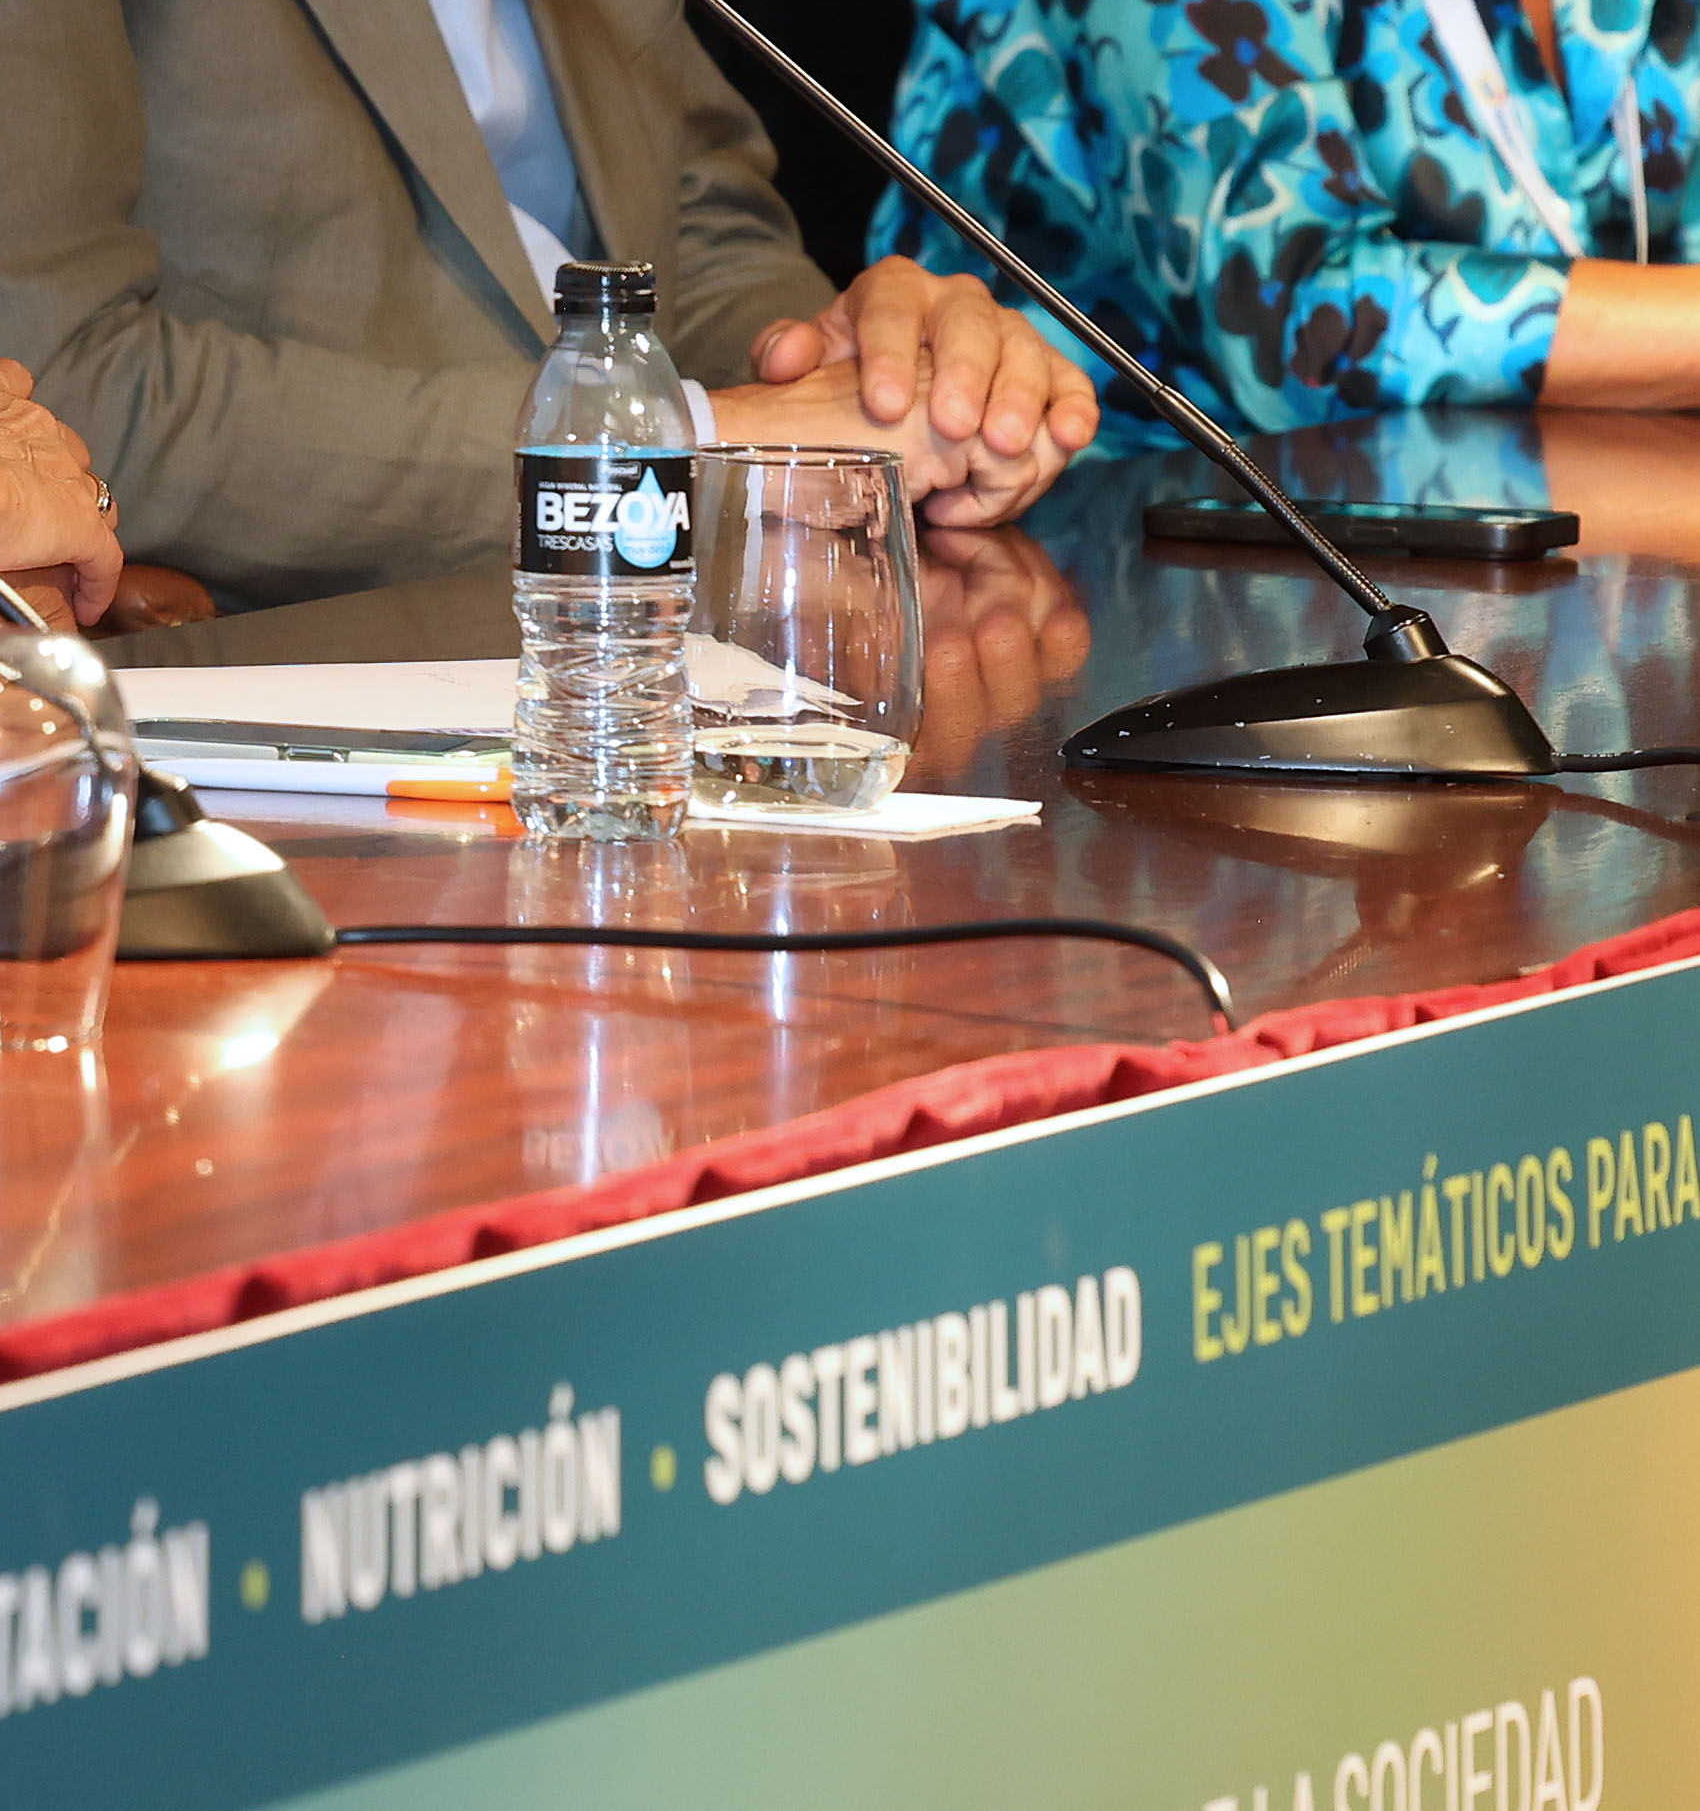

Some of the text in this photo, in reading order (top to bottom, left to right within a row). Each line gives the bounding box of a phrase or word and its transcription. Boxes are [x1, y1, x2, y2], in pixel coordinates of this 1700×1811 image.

[536, 491, 690, 532] BEZOYA
[537, 534, 614, 552] TRESCASAS
[300, 1380, 621, 1624] NUTRICIÓN
[704, 1265, 1142, 1505] SOSTENIBILIDAD
[1192, 1218, 1312, 1363] EJES
[1321, 1152, 1576, 1324] TEMÁTICOS
[1586, 1114, 1700, 1249] PARA
